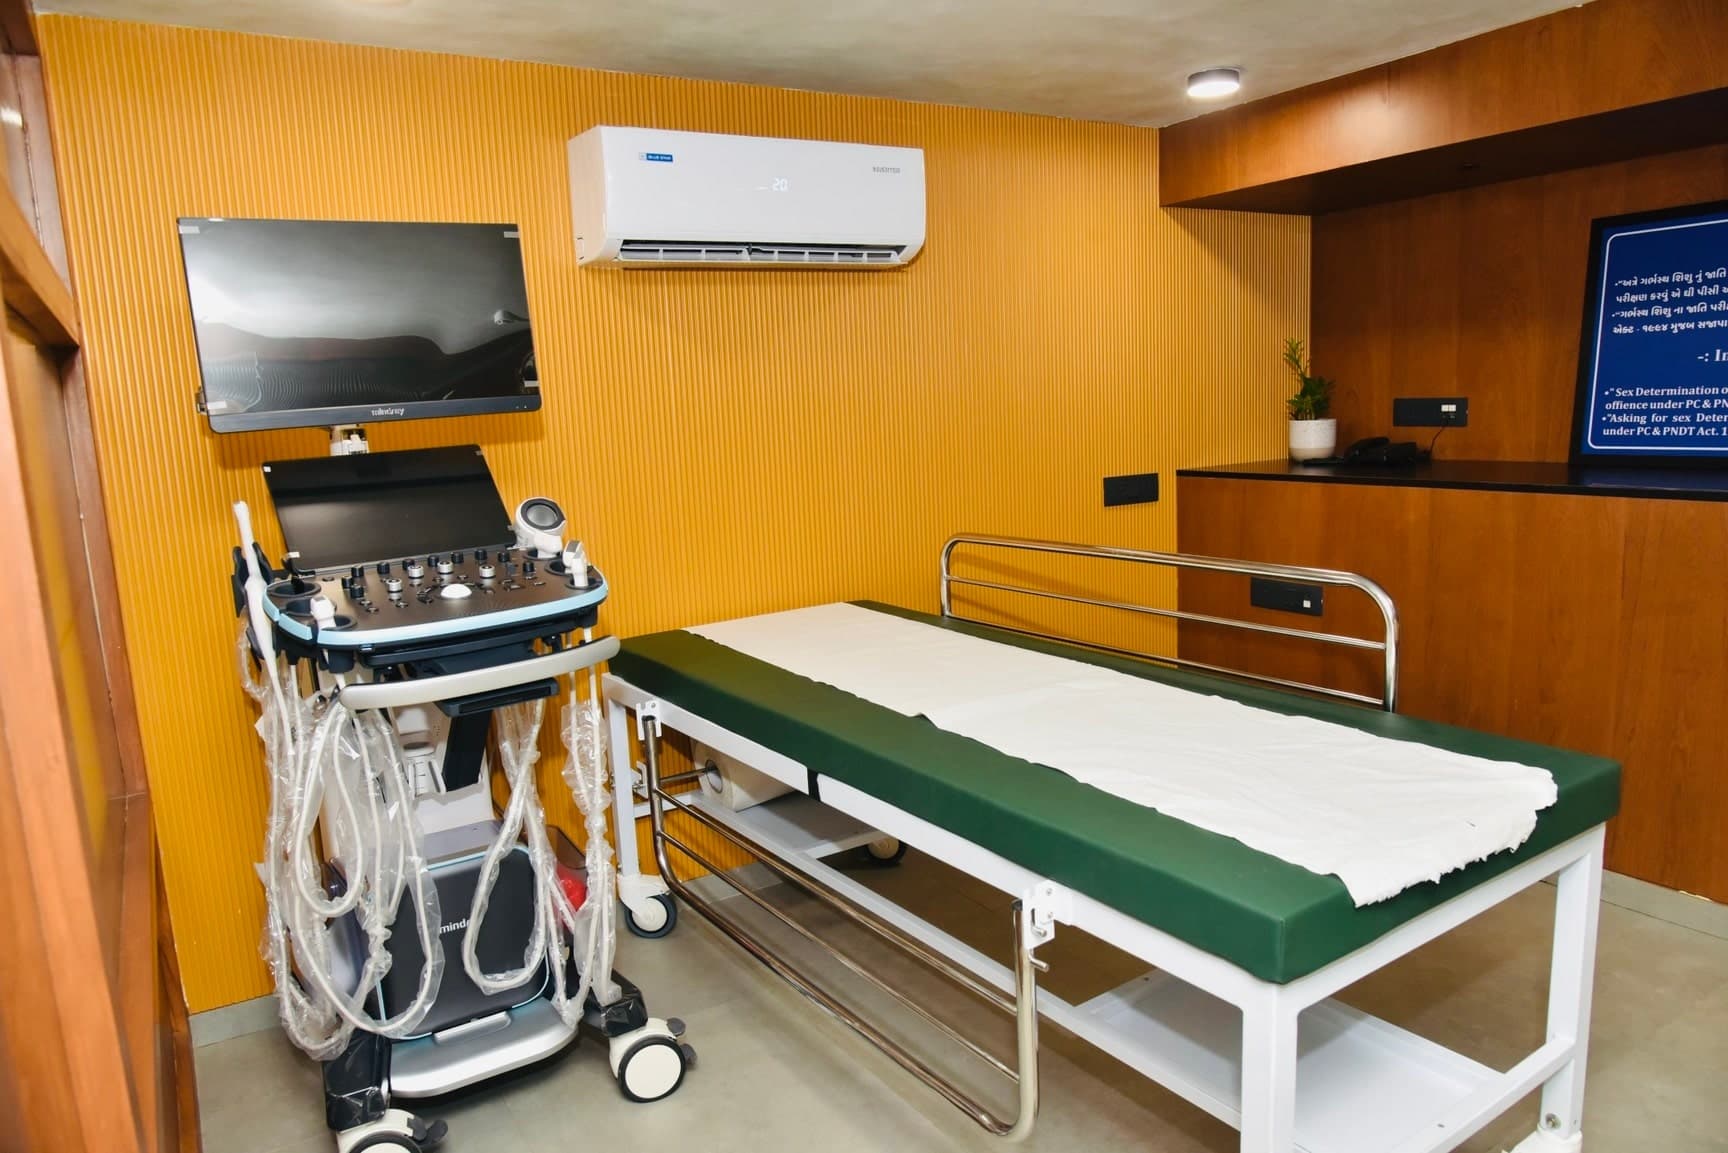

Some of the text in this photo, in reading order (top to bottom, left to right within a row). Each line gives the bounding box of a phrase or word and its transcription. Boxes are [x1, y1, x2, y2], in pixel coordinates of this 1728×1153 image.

[1616, 388, 1634, 397] Sex
[1636, 386, 1719, 396] Determination
[1650, 400, 1684, 409] under
[1686, 399, 1700, 409] PC
[1702, 399, 1711, 408] &
[1651, 413, 1668, 422] for
[1603, 427, 1635, 435] under
[1637, 427, 1650, 435] PC
[1663, 427, 1695, 435] PNDT
[1697, 427, 1719, 435] Act.
